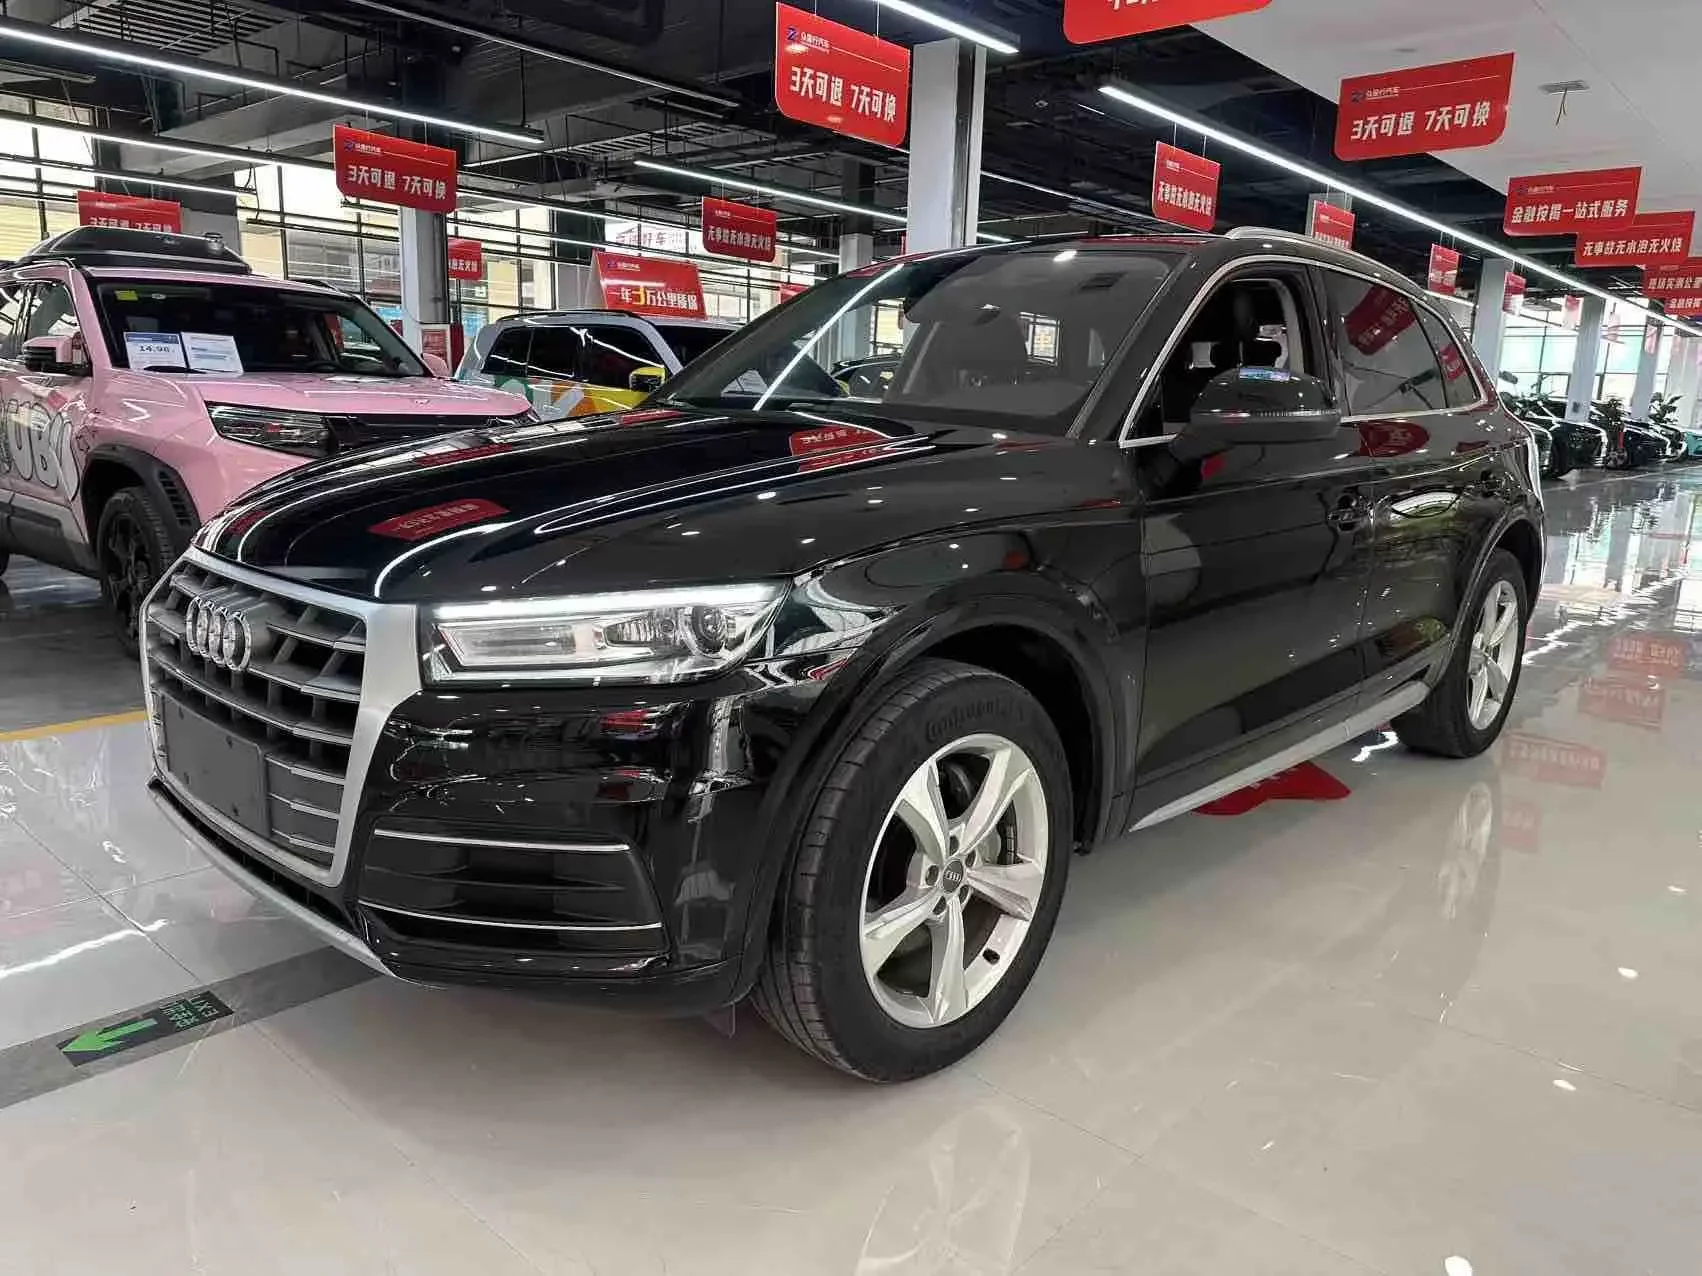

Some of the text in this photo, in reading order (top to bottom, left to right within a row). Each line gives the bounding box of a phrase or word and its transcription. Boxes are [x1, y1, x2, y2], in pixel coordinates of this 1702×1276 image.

[789, 65, 897, 122] 3天可退 7天可换
[1351, 101, 1491, 141] 3天可退 7天可换
[347, 164, 447, 200] 3天可退 7天可换
[1511, 199, 1629, 224] 金融按揭一站式服务
[1582, 237, 1684, 257] 无事故无水泡无火烧
